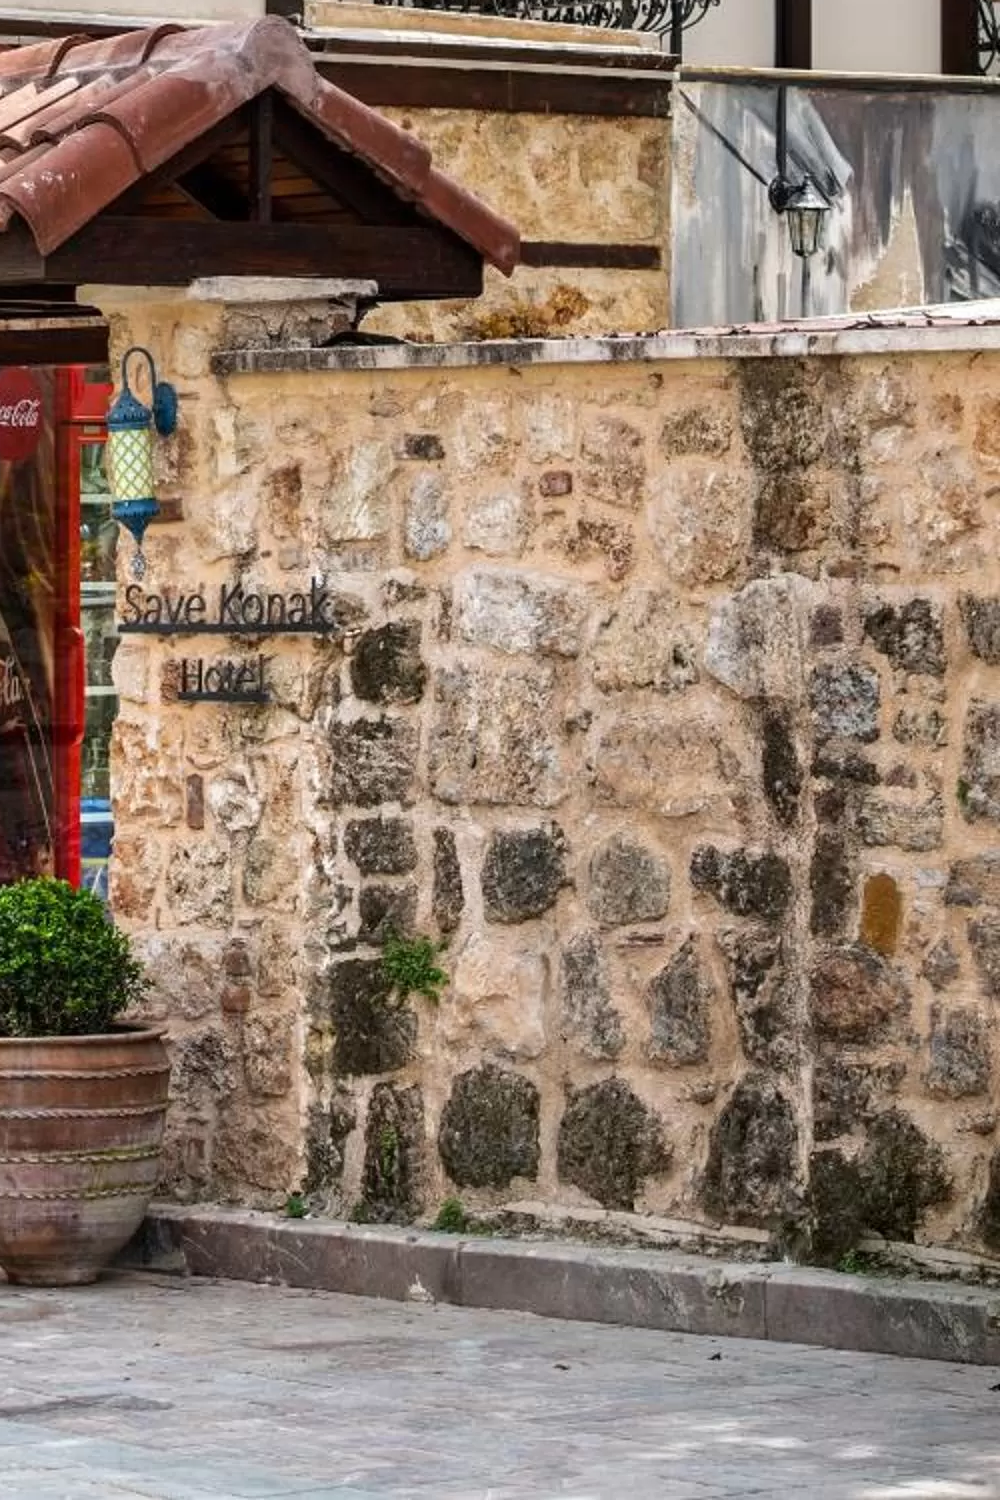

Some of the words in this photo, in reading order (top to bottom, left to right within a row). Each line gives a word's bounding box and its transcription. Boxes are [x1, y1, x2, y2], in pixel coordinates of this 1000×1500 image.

[122, 583, 207, 625] Save
[218, 576, 335, 626] Konak
[181, 653, 265, 694] Hotel
